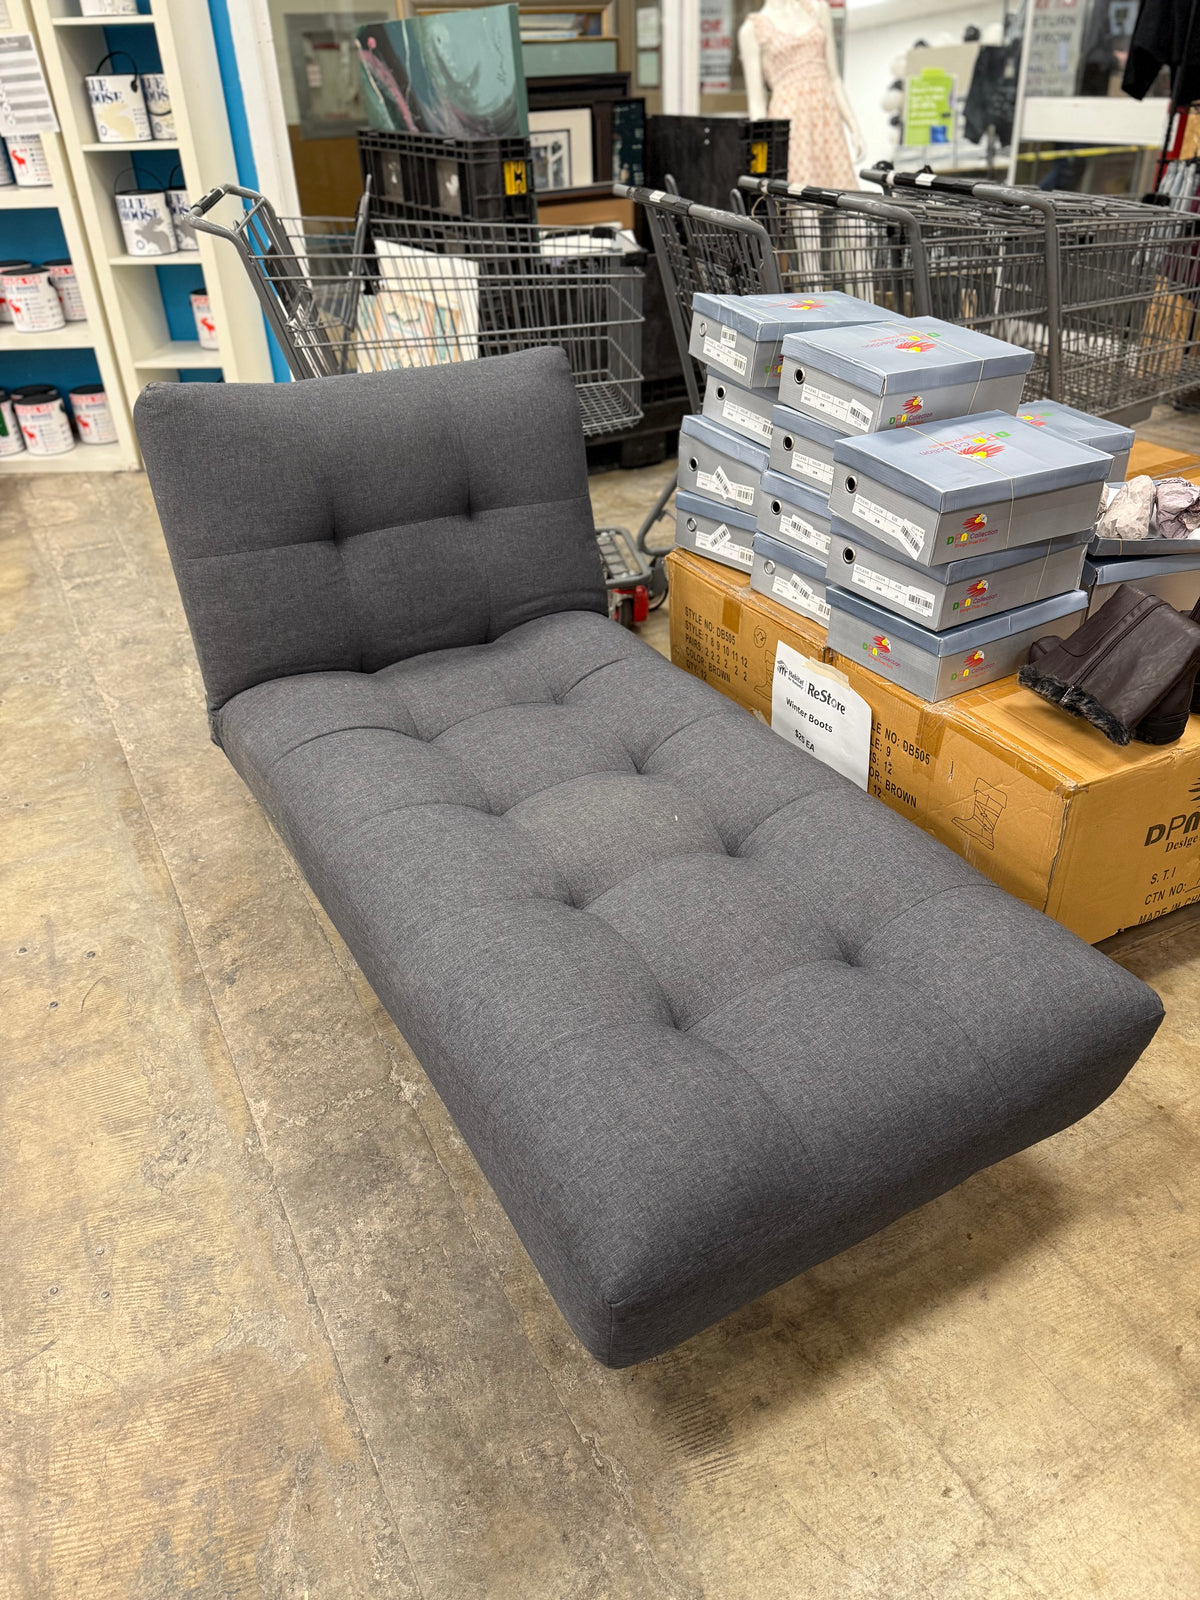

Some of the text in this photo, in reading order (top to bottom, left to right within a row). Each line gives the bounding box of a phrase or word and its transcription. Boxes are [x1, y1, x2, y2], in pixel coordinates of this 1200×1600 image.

[970, 530, 998, 540] Collection
[685, 606, 735, 646] STYLE NO: DB505
[686, 646, 731, 683] COLOR: BROWN
[705, 633, 709, 643] 7
[711, 637, 714, 647] 8
[723, 645, 729, 657] 10
[732, 650, 738, 662] 11
[741, 656, 748, 668] 12
[705, 647, 709, 657] 2
[711, 651, 715, 660] 2
[717, 655, 720, 665] 2
[724, 659, 728, 669] 2
[735, 665, 738, 676] 2
[743, 671, 747, 681] 2
[701, 669, 707, 681] 12
[807, 682, 846, 714] ReStore
[786, 697, 833, 733] Winter Boots
[795, 729, 815, 752] $25 EA
[885, 728, 900, 747] NO:
[903, 740, 930, 765] DB505
[886, 746, 891, 757] 9
[884, 761, 893, 775] 12
[873, 784, 882, 798] 12
[885, 779, 917, 808] BROWN
[1145, 883, 1187, 905] CTN NO:
